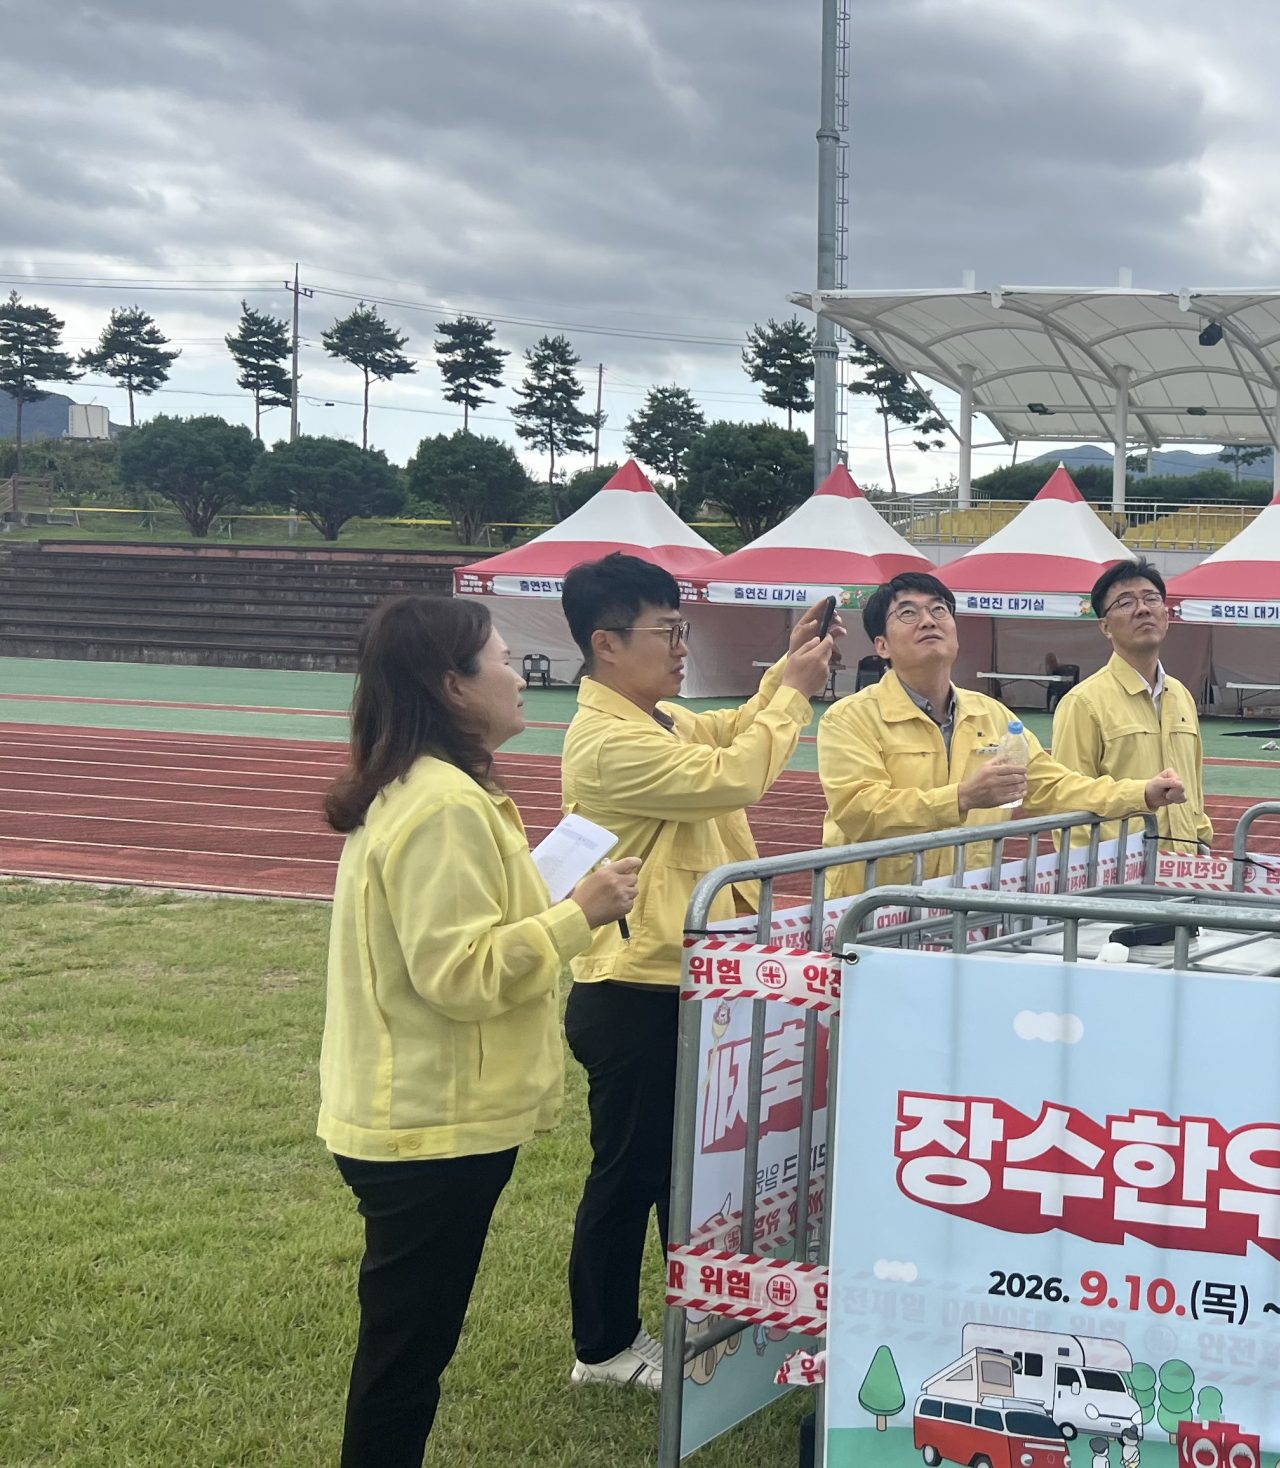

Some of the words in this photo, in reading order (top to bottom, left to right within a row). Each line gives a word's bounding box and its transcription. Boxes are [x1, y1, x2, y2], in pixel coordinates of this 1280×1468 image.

[519, 579, 552, 592] 출연진
[733, 586, 768, 601] 출연진
[771, 588, 807, 602] 대기실
[966, 596, 1005, 611] 출연진
[1008, 597, 1045, 612] 대기실
[1210, 604, 1250, 619] 출연진
[688, 955, 743, 985] 위험
[699, 1264, 751, 1299] 위험
[987, 1269, 1070, 1304] 2026.
